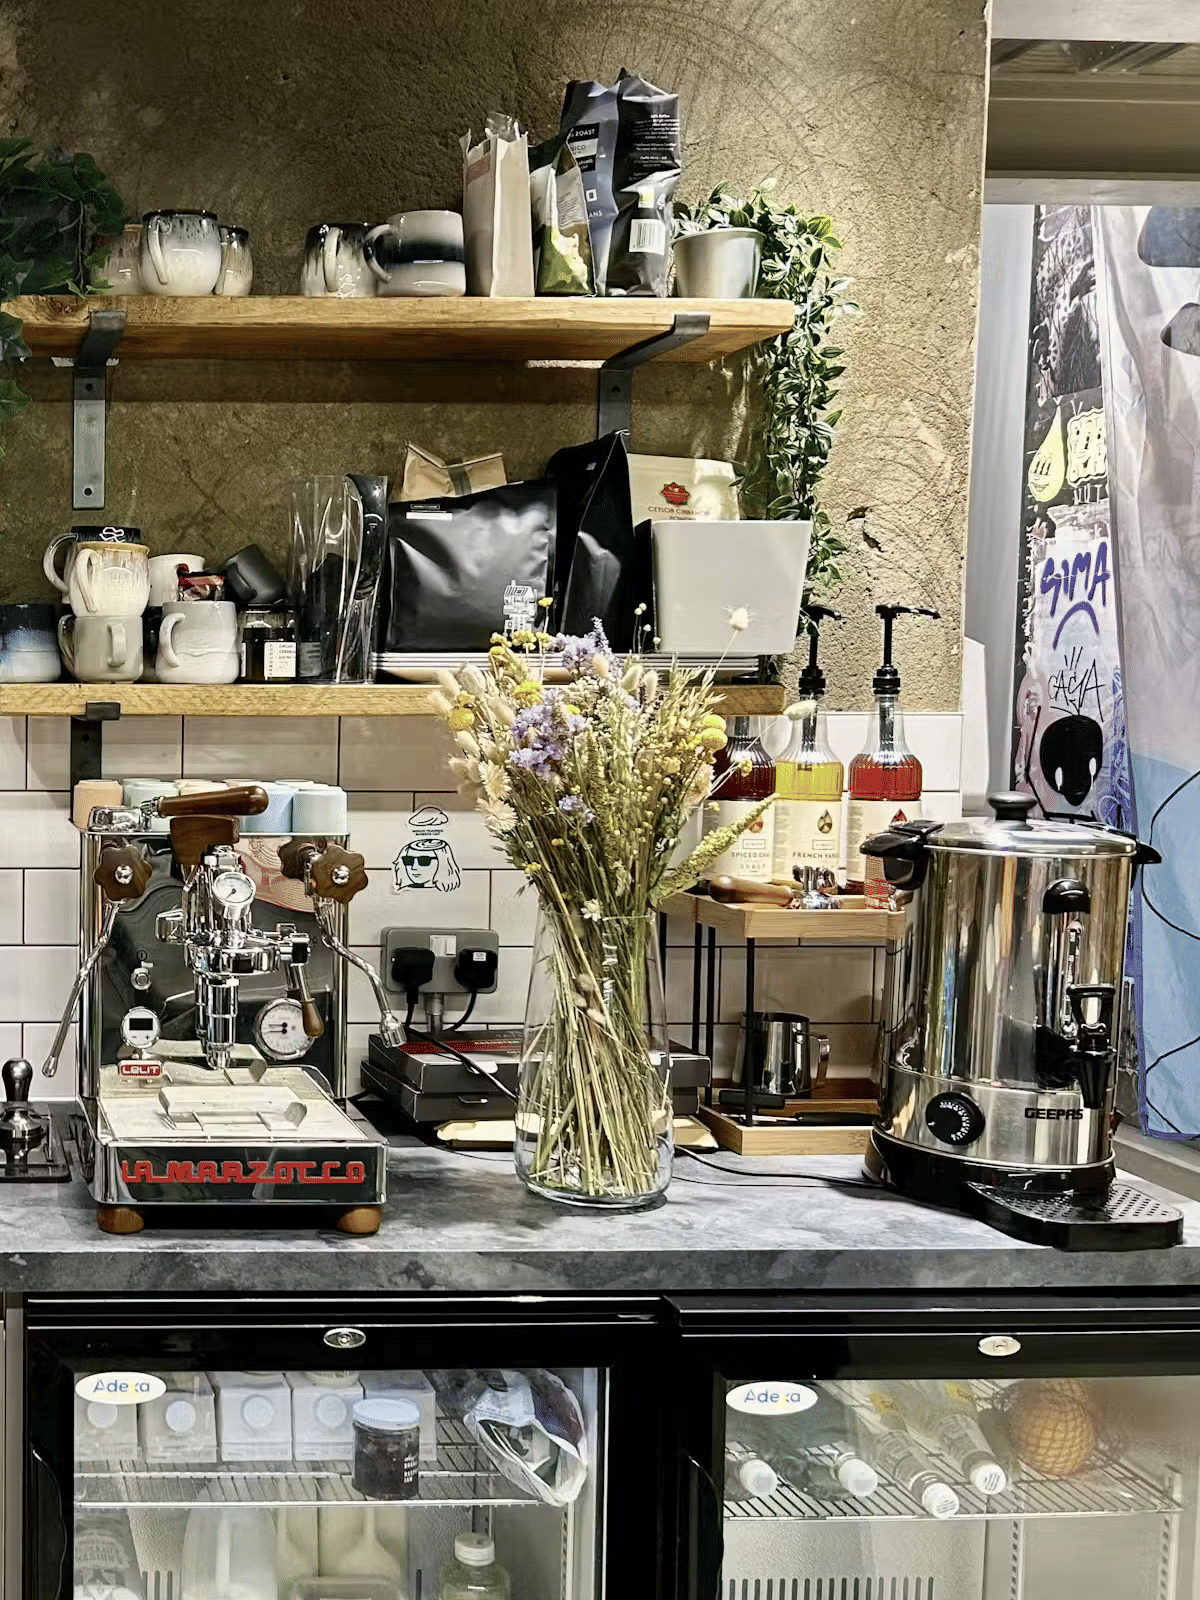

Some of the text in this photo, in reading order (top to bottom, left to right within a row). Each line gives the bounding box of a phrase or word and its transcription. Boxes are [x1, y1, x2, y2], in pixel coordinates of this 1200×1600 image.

[575, 128, 595, 137] ROAST
[1025, 1107, 1084, 1120] GEEPAS
[122, 1160, 153, 1184] LA
